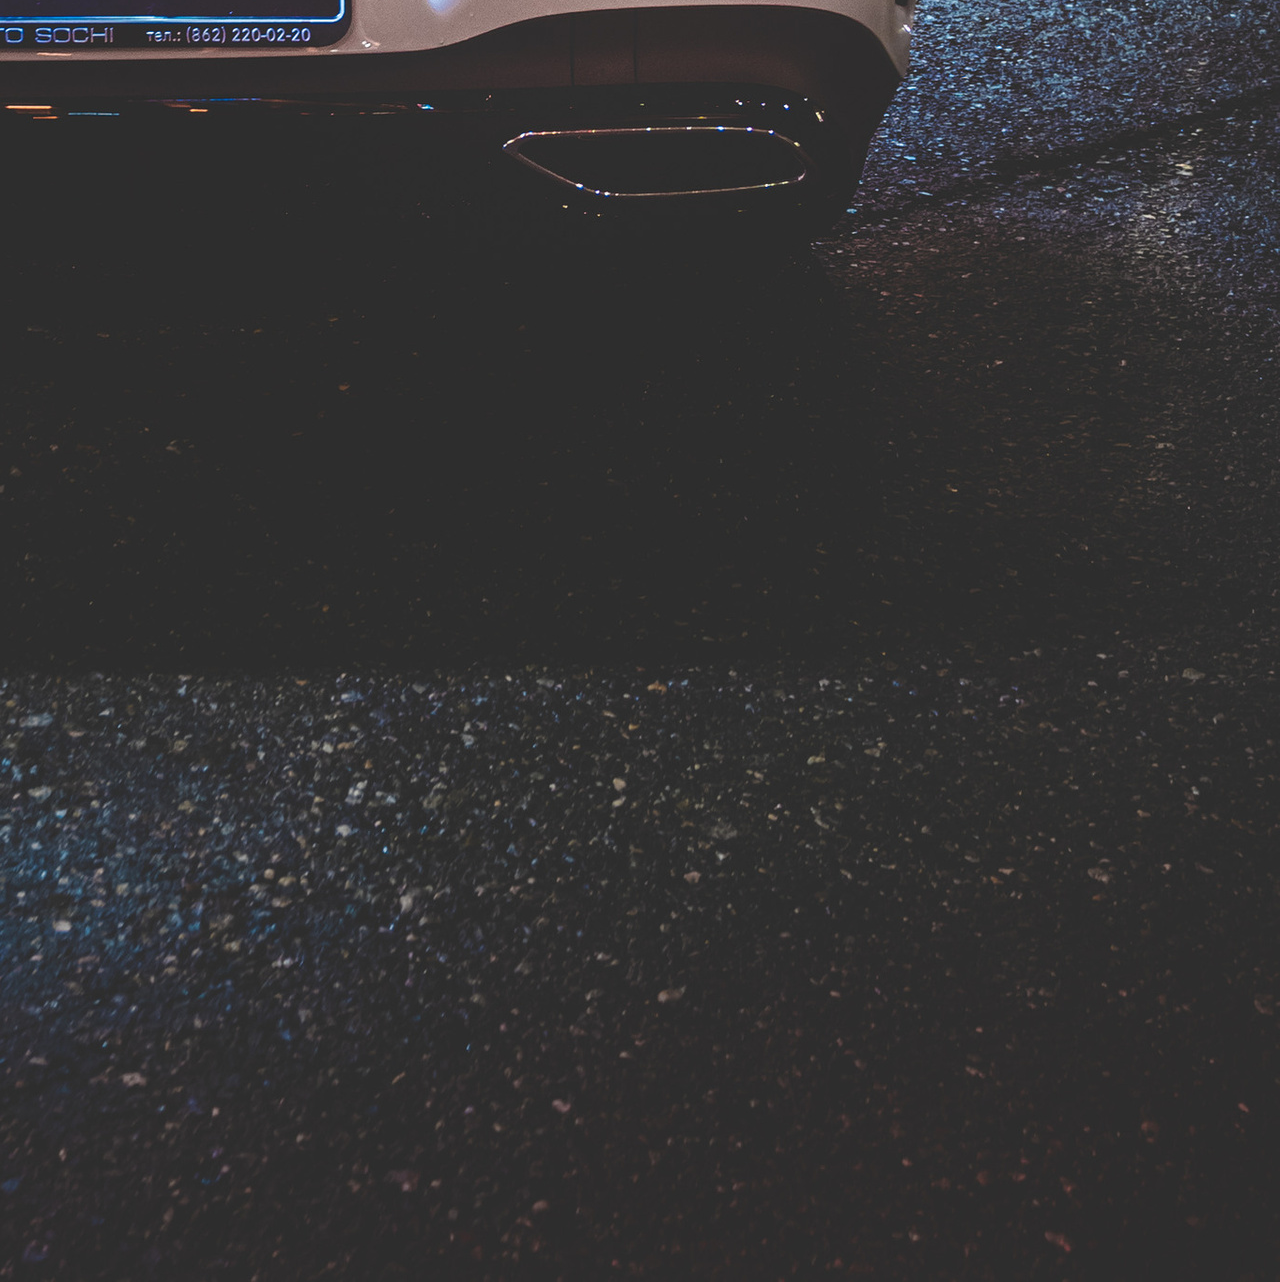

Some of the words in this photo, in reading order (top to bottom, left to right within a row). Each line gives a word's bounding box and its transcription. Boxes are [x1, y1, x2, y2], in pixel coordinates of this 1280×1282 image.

[34, 26, 115, 44] SOCHI
[146, 29, 182, 43] тел.:
[185, 26, 227, 44] (862)
[231, 26, 312, 43] 220-02-20
